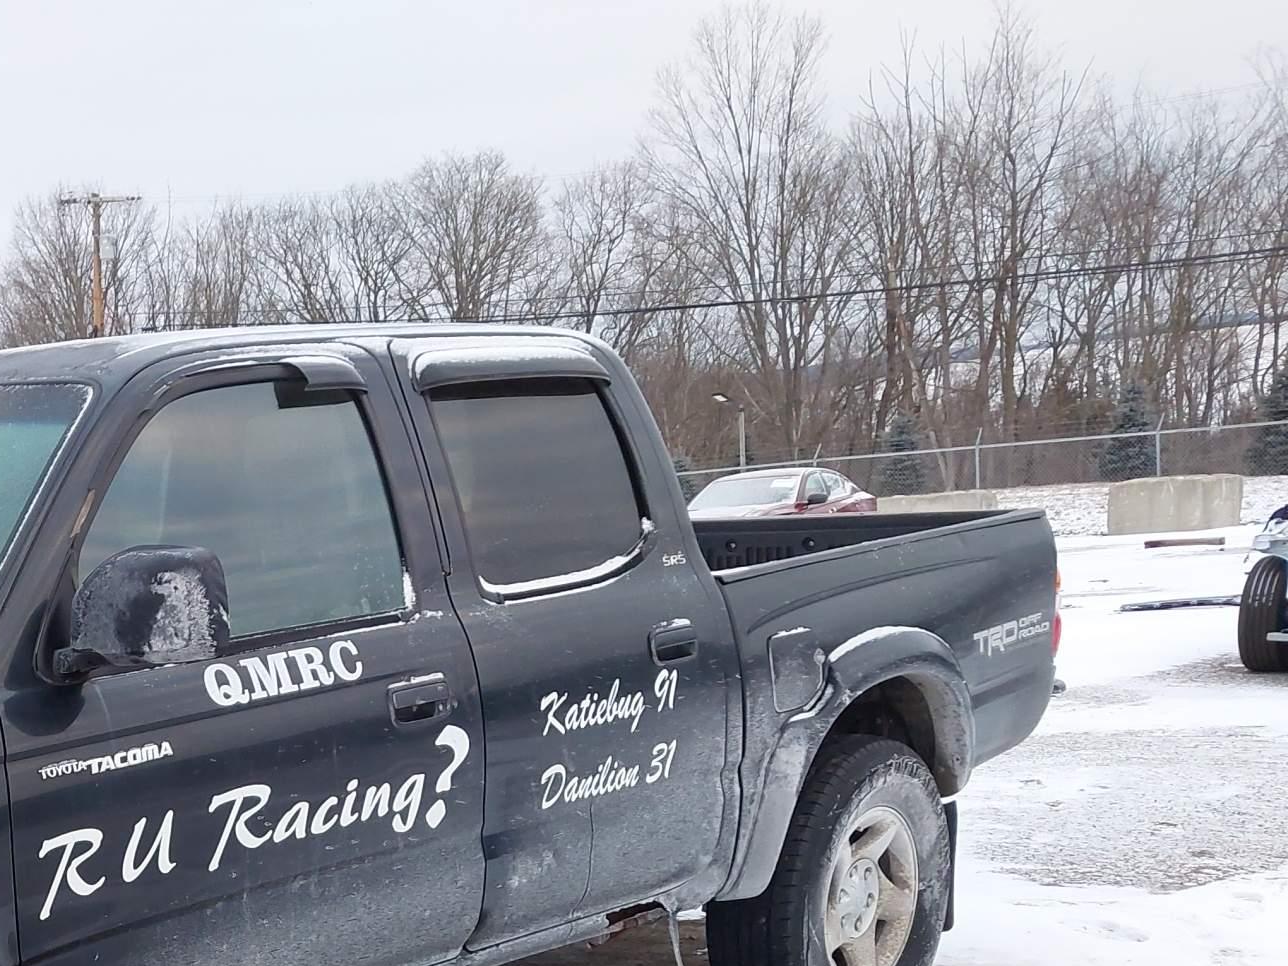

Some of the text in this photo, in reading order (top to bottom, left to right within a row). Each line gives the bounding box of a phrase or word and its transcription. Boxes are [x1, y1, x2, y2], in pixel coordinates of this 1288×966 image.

[663, 554, 686, 566] SR5
[973, 620, 1018, 657] TRD
[1018, 612, 1043, 628] OFF
[1018, 621, 1050, 640] ROAD
[204, 640, 364, 706] QMRC
[540, 668, 678, 736] Katiebug 91
[38, 741, 174, 780] TOYOTA TACOMA
[540, 739, 677, 810] Danilion 31
[38, 724, 471, 921] R U Racing?
